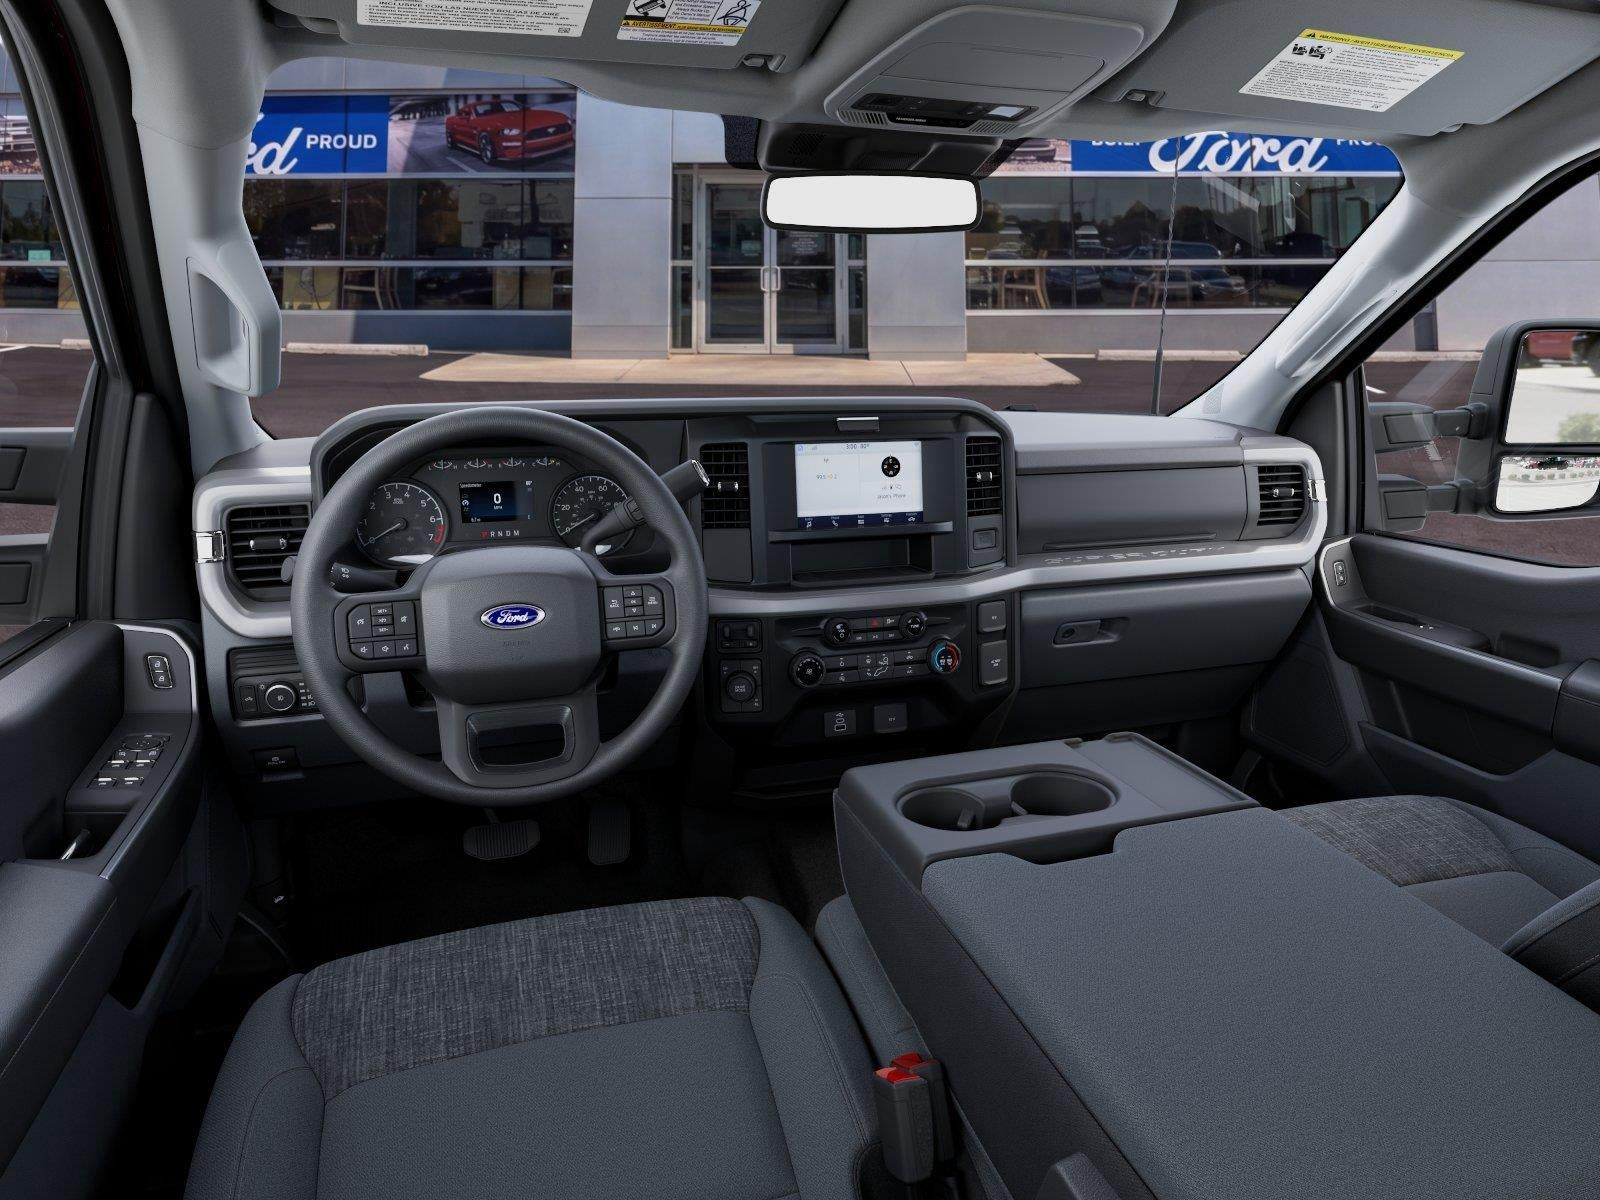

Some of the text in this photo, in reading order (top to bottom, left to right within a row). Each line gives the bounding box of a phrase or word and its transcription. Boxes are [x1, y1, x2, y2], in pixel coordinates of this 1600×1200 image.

[306, 134, 378, 149] PROUD
[1148, 130, 1328, 173] Ford
[493, 493, 502, 504] 0
[496, 609, 530, 624] Ford
